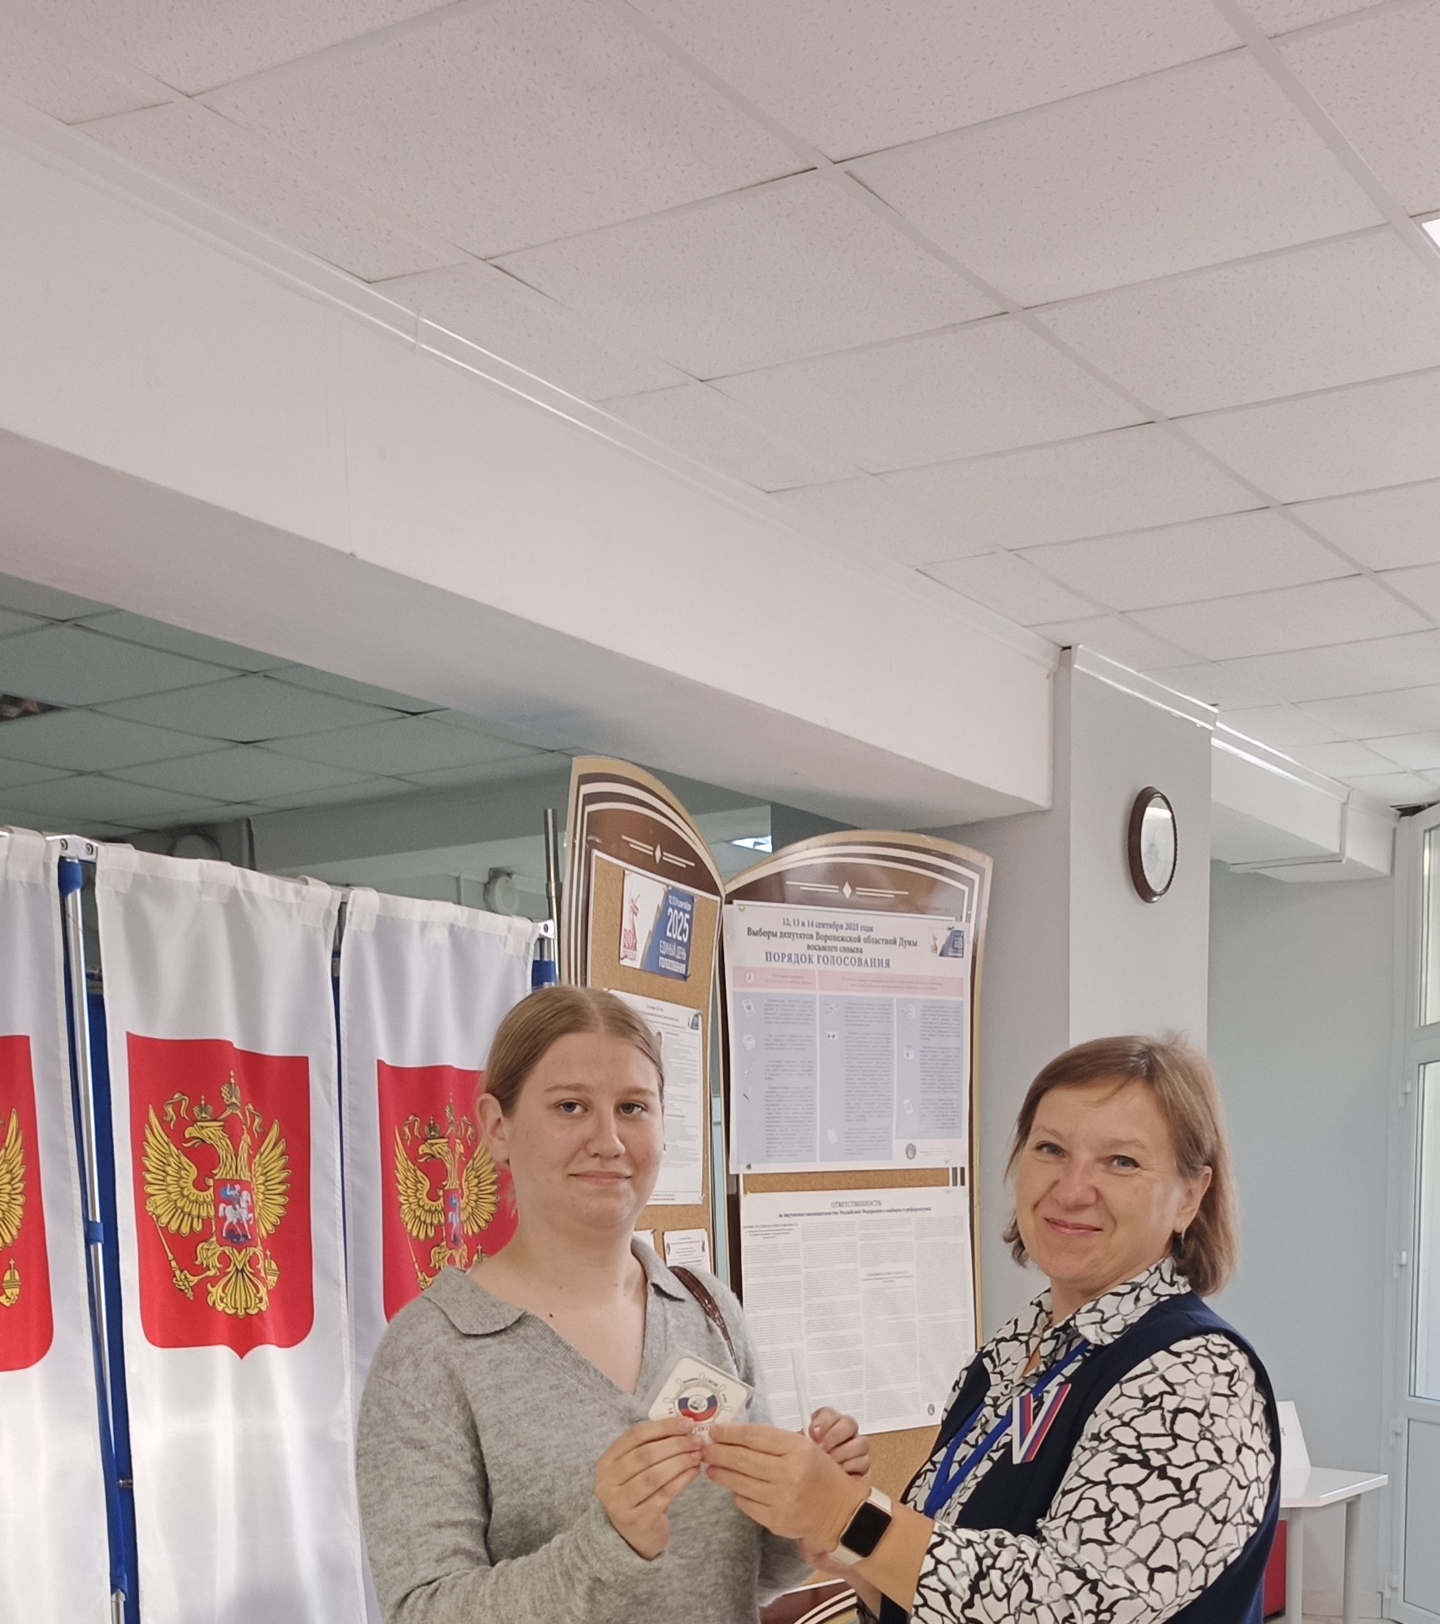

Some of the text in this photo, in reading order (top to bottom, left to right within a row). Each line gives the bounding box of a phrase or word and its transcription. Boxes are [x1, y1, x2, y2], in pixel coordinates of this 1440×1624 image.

[666, 907, 690, 943] 2025
[747, 926, 778, 940] Выборы
[779, 930, 814, 941] депутатов
[765, 951, 891, 969] ПОРЯДОК ГОЛОСОВАНИЯ
